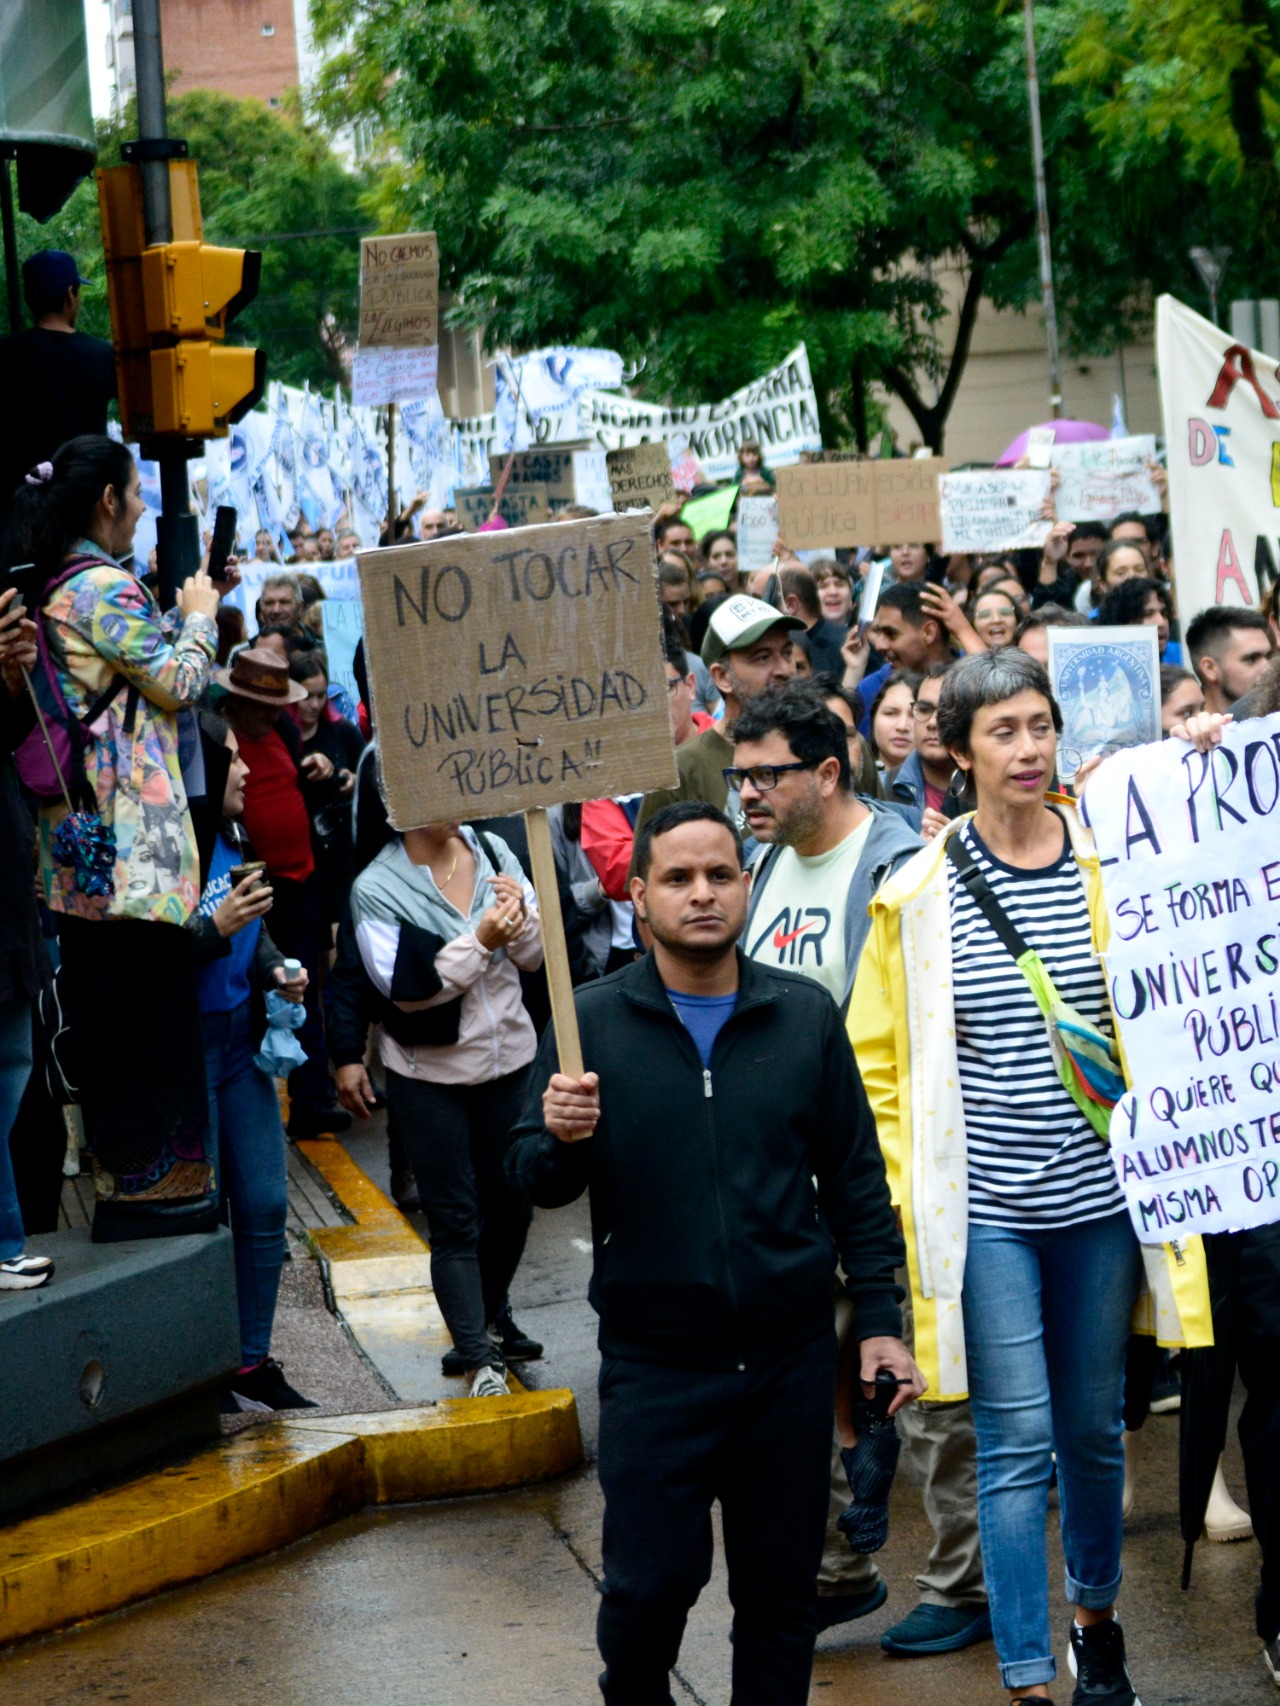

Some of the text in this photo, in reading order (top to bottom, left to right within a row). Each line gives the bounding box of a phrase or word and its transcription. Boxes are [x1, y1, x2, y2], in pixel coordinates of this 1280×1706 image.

[1188, 418, 1235, 469] DE
[611, 473, 673, 494] DERECHOS
[393, 539, 640, 626] NO TOCAR
[479, 632, 527, 675] LA
[1061, 646, 1148, 688] UNIVERSIDAD ARGENTINA
[404, 670, 647, 749] UNIVERSIDAD
[751, 906, 831, 967] AIR
[1116, 893, 1154, 942] SE
[1165, 877, 1252, 928] FORMA
[1121, 1095, 1141, 1140] Y
[1149, 1072, 1237, 1127] QUIERE
[1122, 1122, 1250, 1185] ALUMNOS
[1137, 1184, 1223, 1234] MISMA
